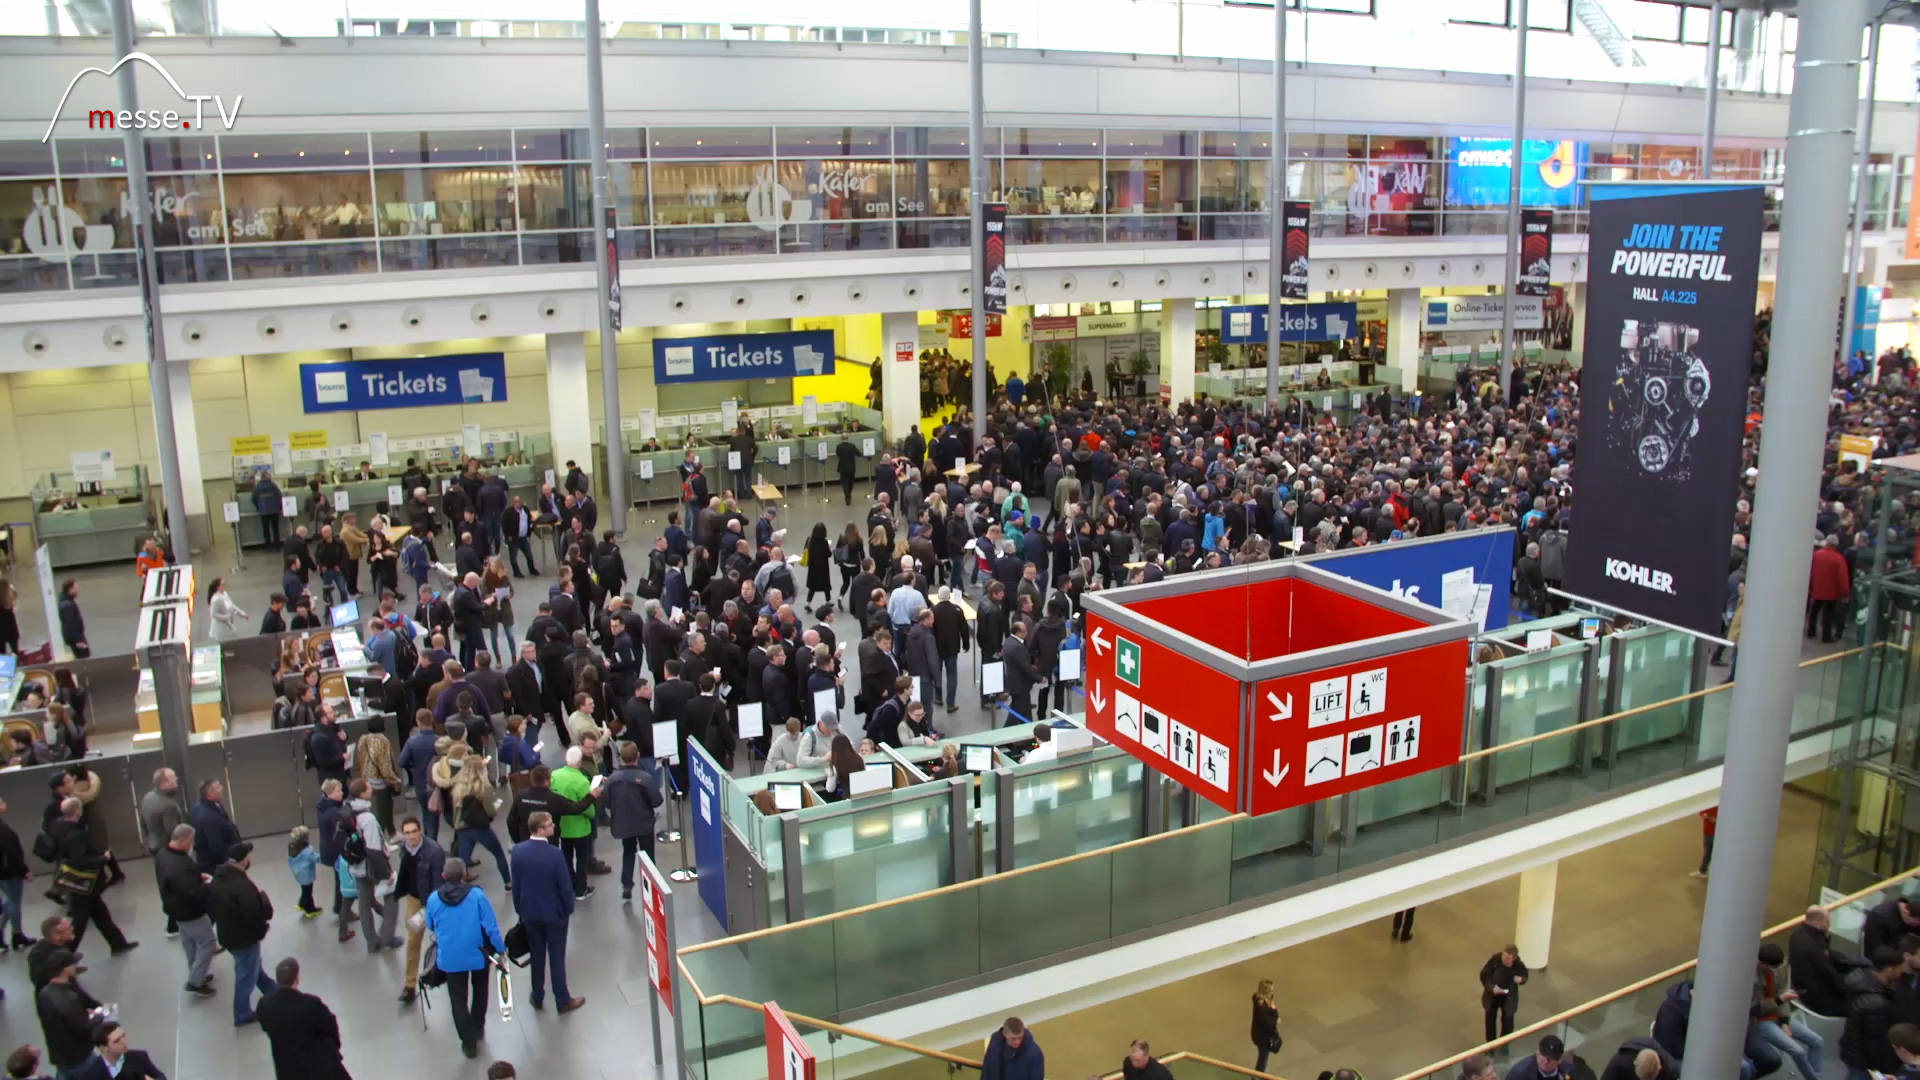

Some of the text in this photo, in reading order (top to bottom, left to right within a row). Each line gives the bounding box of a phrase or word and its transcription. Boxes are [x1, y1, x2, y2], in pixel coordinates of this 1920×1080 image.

[819, 169, 877, 198] Käfer
[866, 197, 924, 213] am See
[188, 218, 266, 238] am See
[1622, 223, 1723, 252] JOIN THE
[1610, 250, 1732, 281] POWERFUL.
[1632, 286, 1697, 304] HALL A4.225
[1261, 311, 1318, 332] Tckets
[706, 343, 783, 368] Tickets
[362, 370, 448, 397] Tickets
[1605, 557, 1673, 594] KOHLER
[1371, 672, 1385, 682] WC
[1315, 693, 1342, 712] LIFT
[1216, 746, 1227, 760] WC
[692, 755, 716, 796] Tickets
